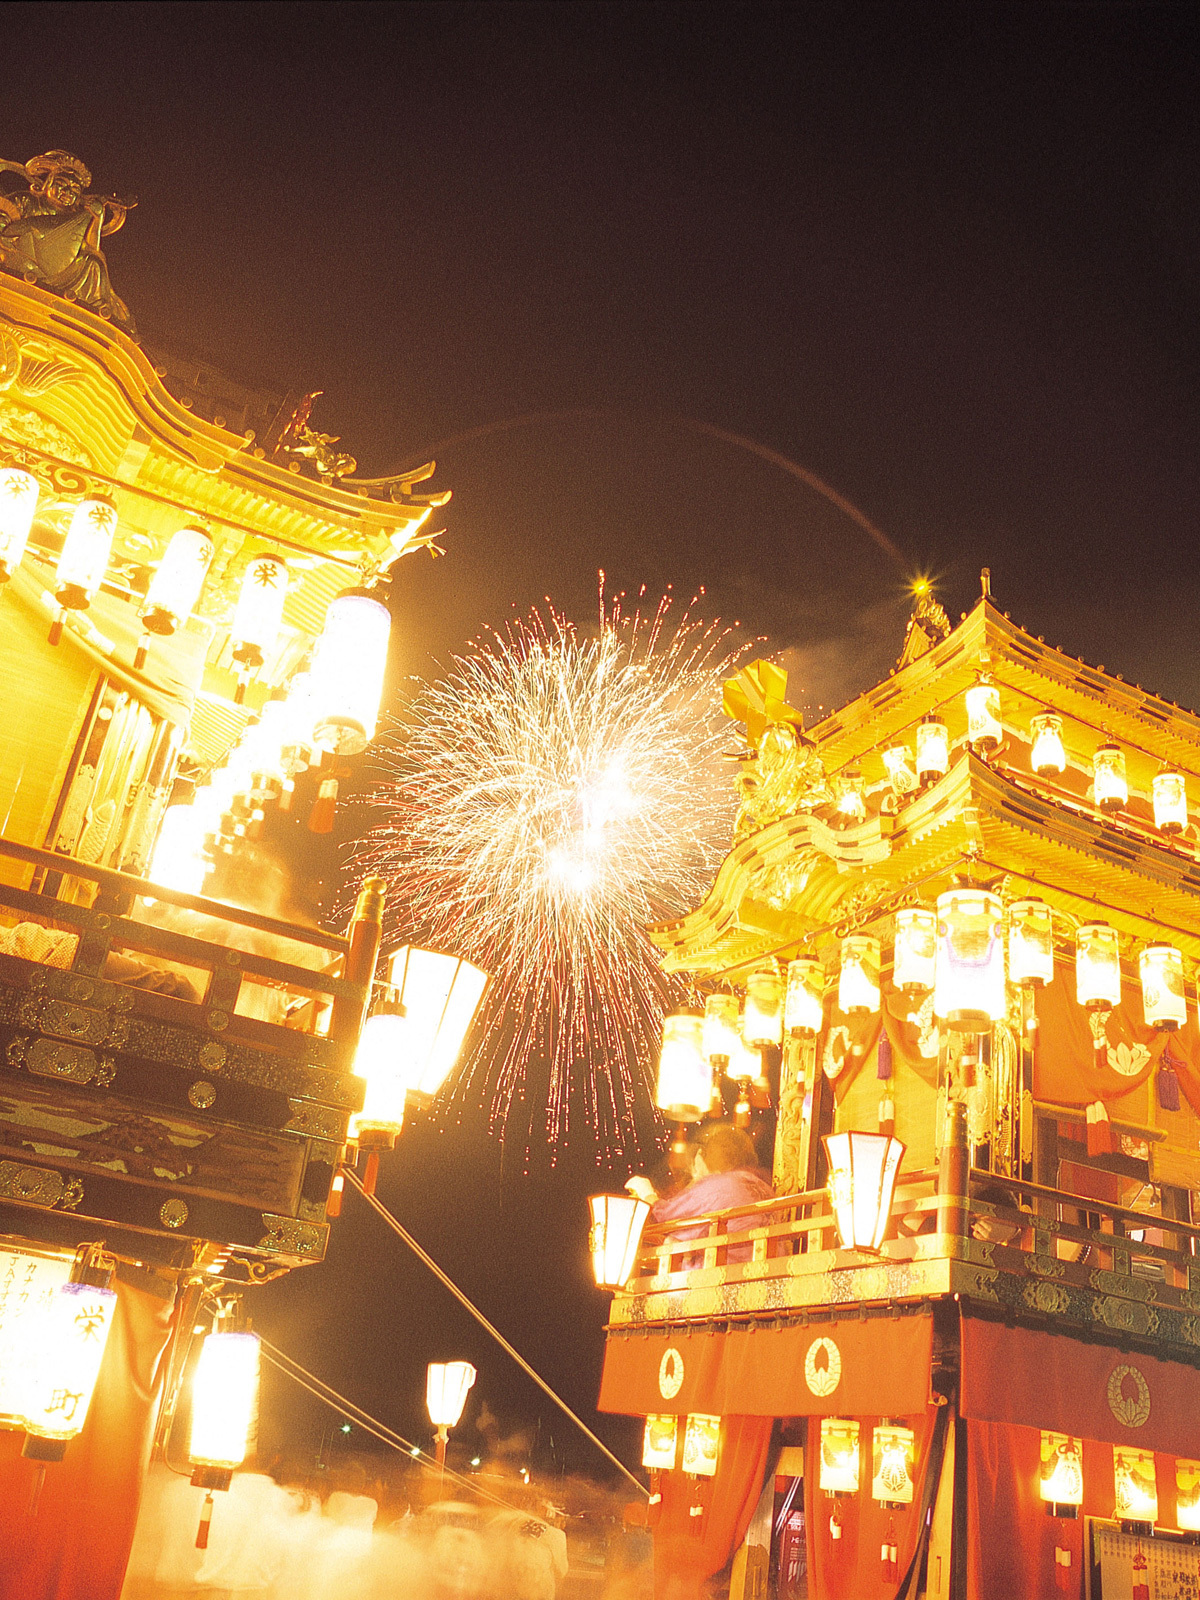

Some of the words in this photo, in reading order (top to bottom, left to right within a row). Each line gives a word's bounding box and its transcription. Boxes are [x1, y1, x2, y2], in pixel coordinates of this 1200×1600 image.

[88, 504, 113, 536] 栄
[252, 562, 278, 590] 栄
[44, 1304, 106, 1422] 栄町
